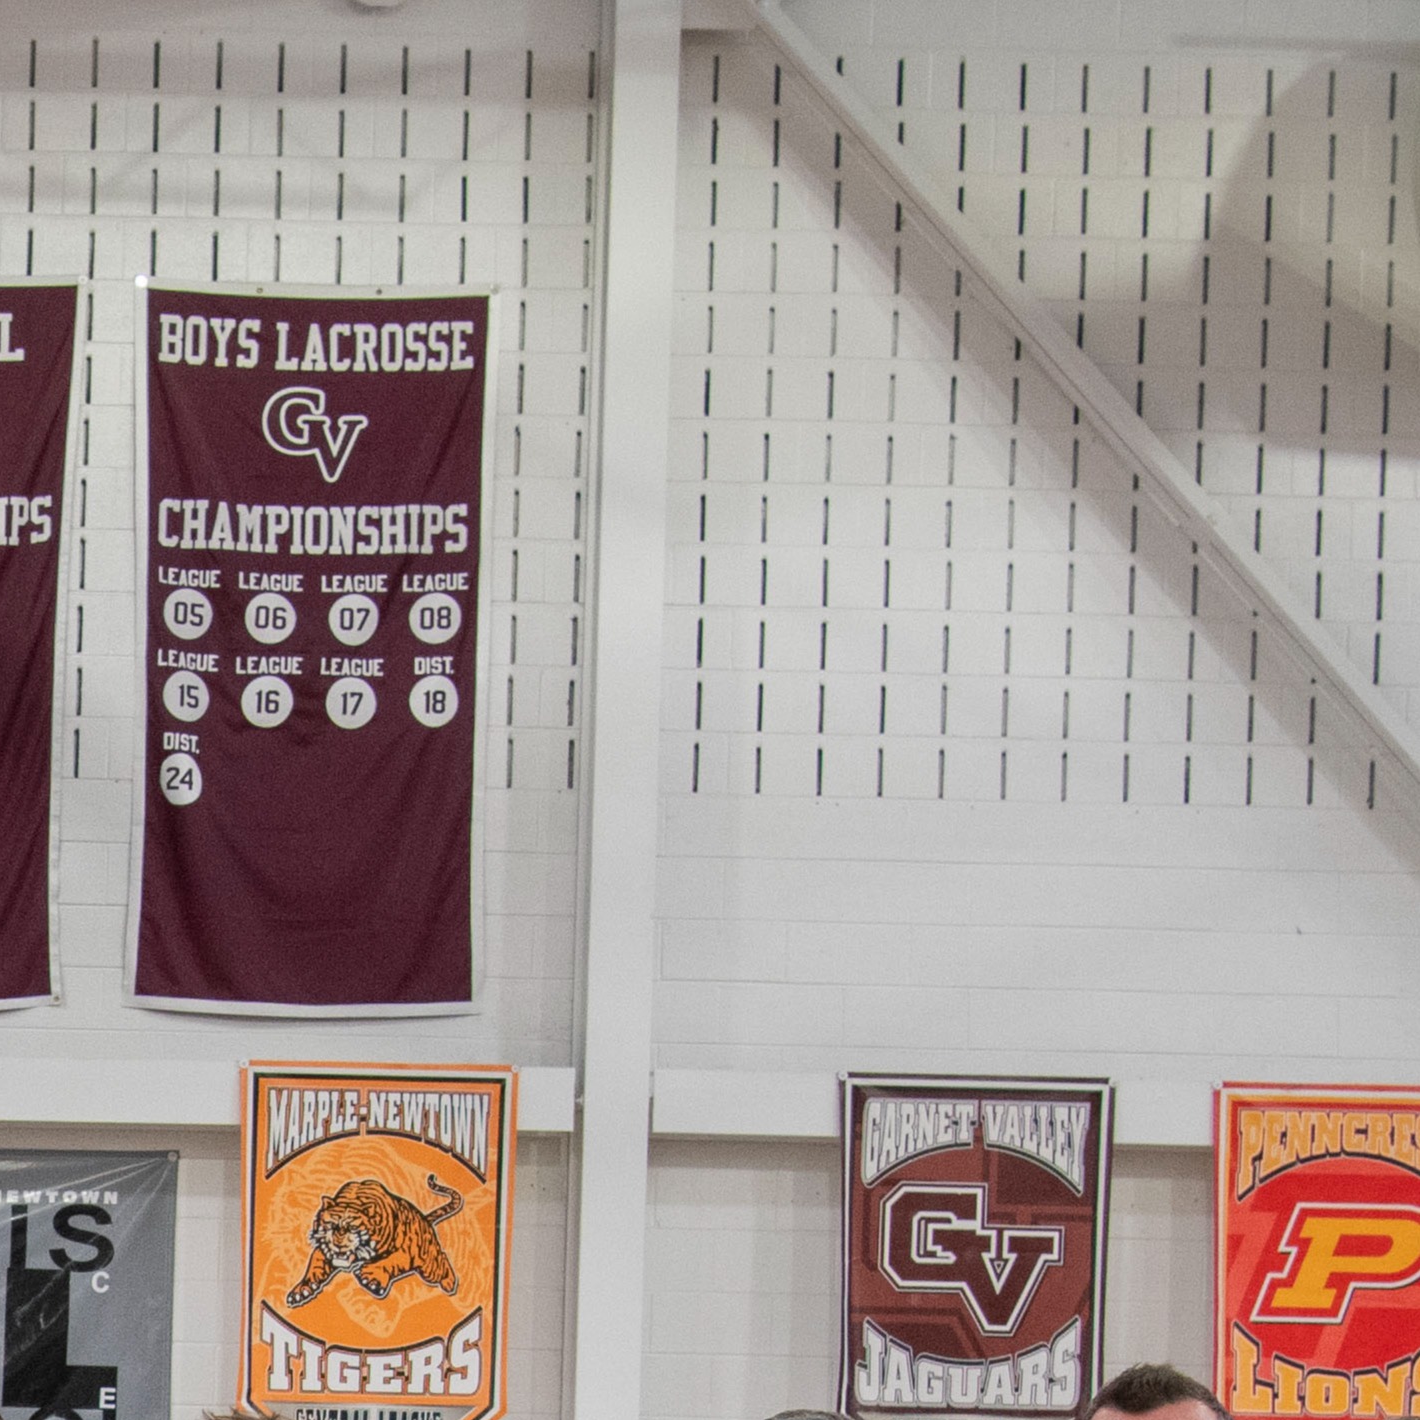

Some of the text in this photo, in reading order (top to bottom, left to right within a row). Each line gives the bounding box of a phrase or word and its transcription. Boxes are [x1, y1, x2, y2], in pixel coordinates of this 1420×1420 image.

[158, 314, 474, 372] BOYS LACROSSE
[262, 386, 368, 482] GV
[158, 498, 468, 555] CHAMPIONSHIPS
[158, 566, 221, 588] LEAGUE
[239, 572, 303, 592] LEAGUE
[321, 575, 387, 592] LEAGUE
[402, 573, 468, 592] LEAGUE
[173, 602, 204, 627] 05
[255, 606, 287, 630] 06
[339, 608, 370, 632] 07
[420, 606, 451, 629] 08
[163, 732, 200, 754] DIST.
[166, 767, 193, 791] 24
[266, 1088, 489, 1182] MARPLE-NEWTOWN
[864, 1101, 1089, 1195] GARNET VALLEY
[10, 1203, 115, 1272] IS
[880, 1182, 1064, 1336] GV
[1251, 1202, 1420, 1323] P
[262, 1300, 482, 1395] TIGERS
[857, 1316, 1080, 1407] JAGUARS
